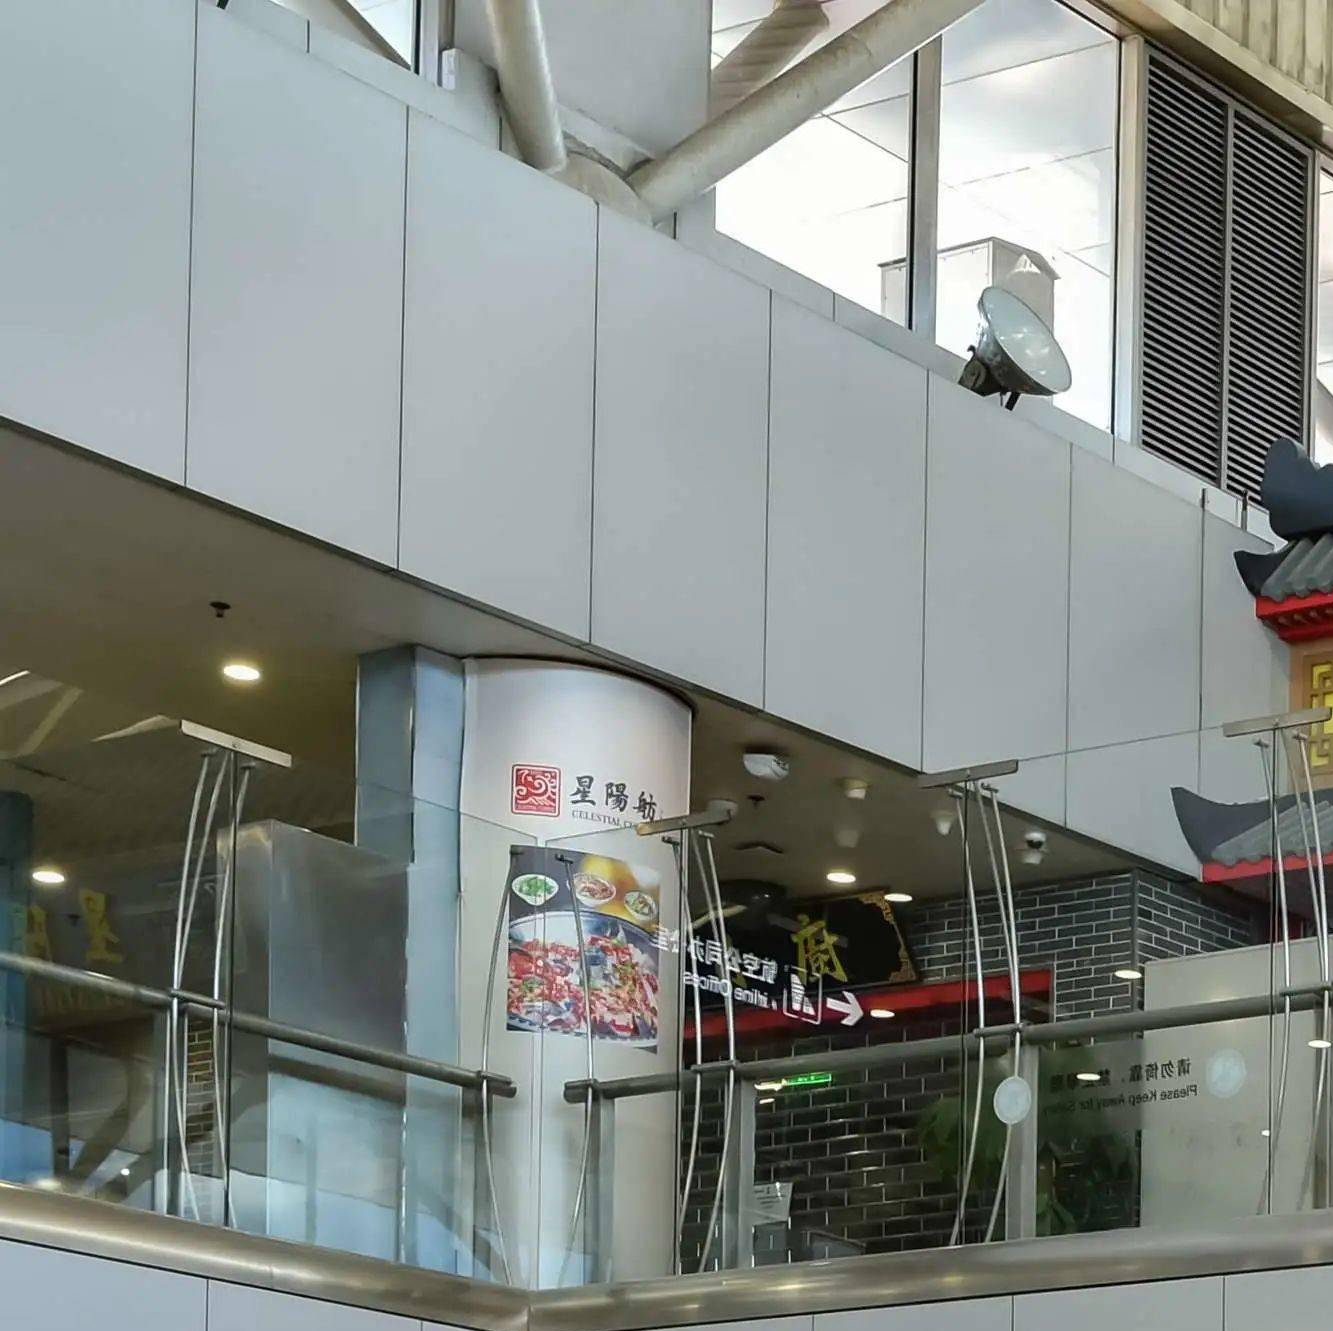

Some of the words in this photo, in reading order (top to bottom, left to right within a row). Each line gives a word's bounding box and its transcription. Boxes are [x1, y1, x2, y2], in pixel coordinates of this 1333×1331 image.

[569, 775, 658, 821] 星陽舫
[571, 808, 622, 828] CELESTIAL
